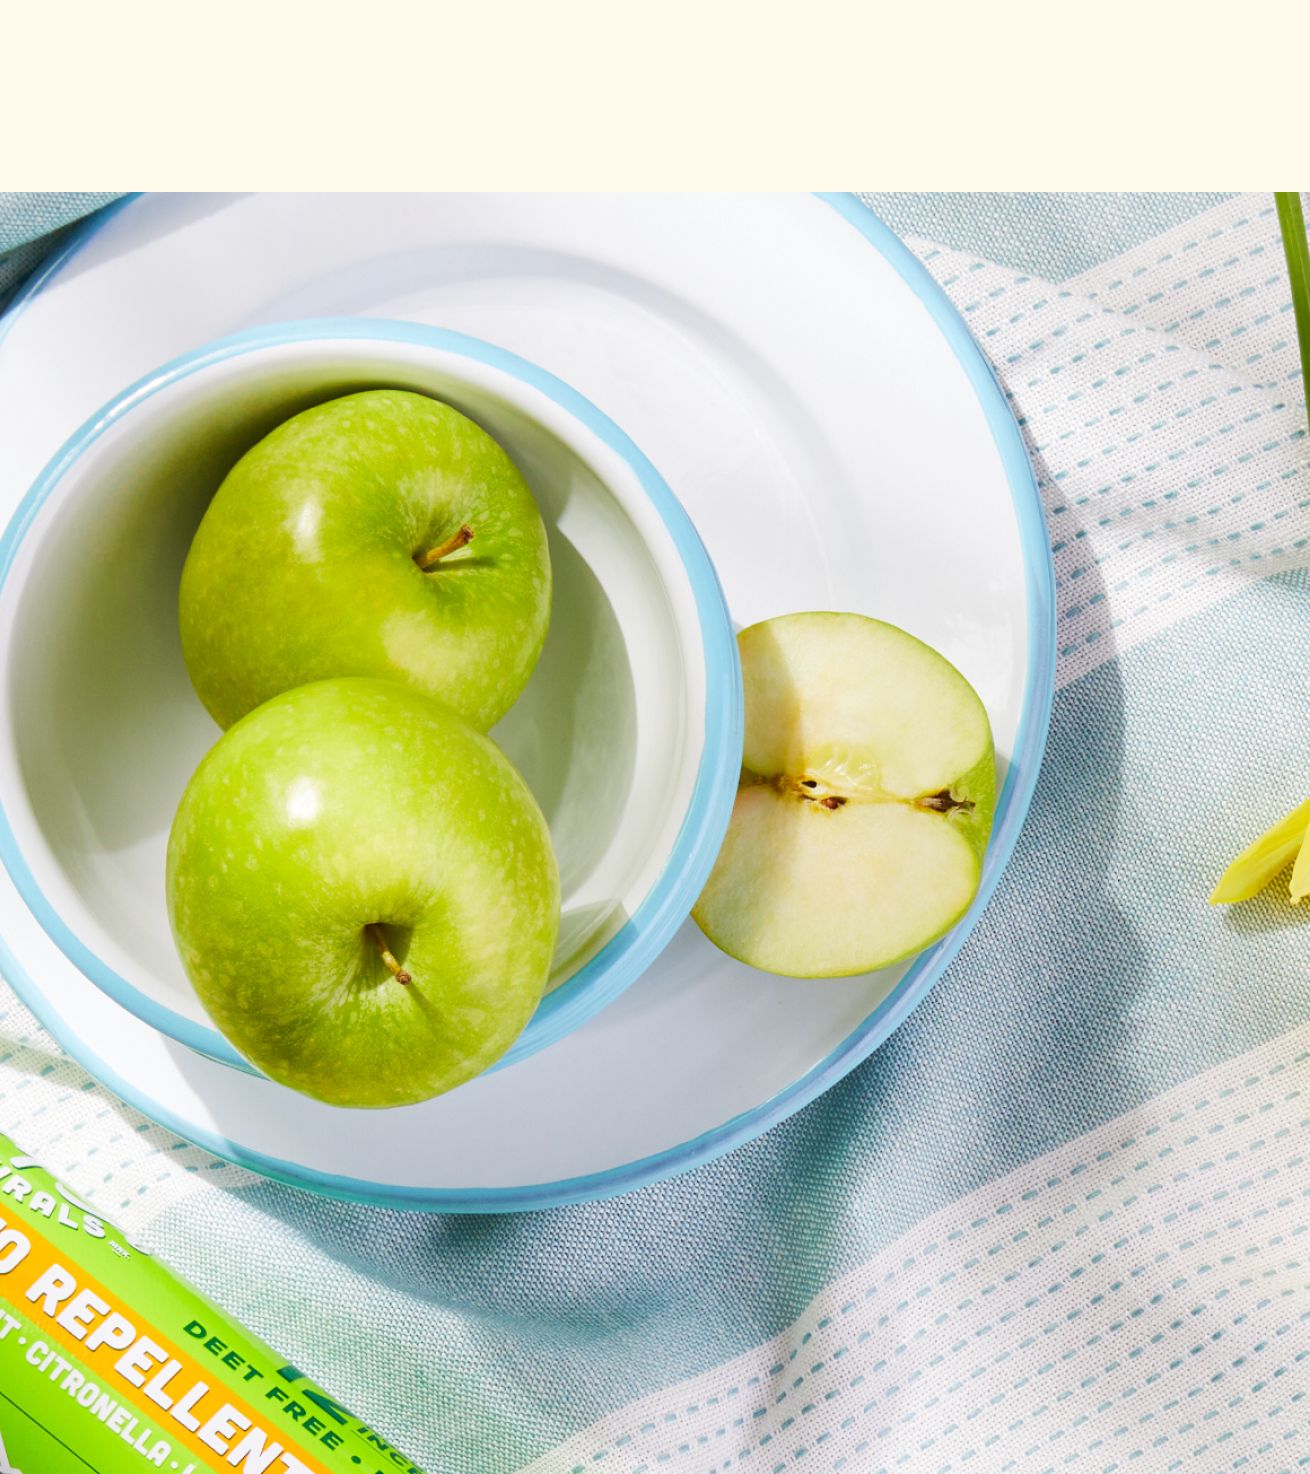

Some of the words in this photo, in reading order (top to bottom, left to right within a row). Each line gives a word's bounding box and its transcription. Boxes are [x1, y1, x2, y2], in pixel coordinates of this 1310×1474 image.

[21, 1338, 173, 1468] CITRONELLA
[182, 1318, 263, 1388] DEET
[265, 1384, 345, 1454] FREE
